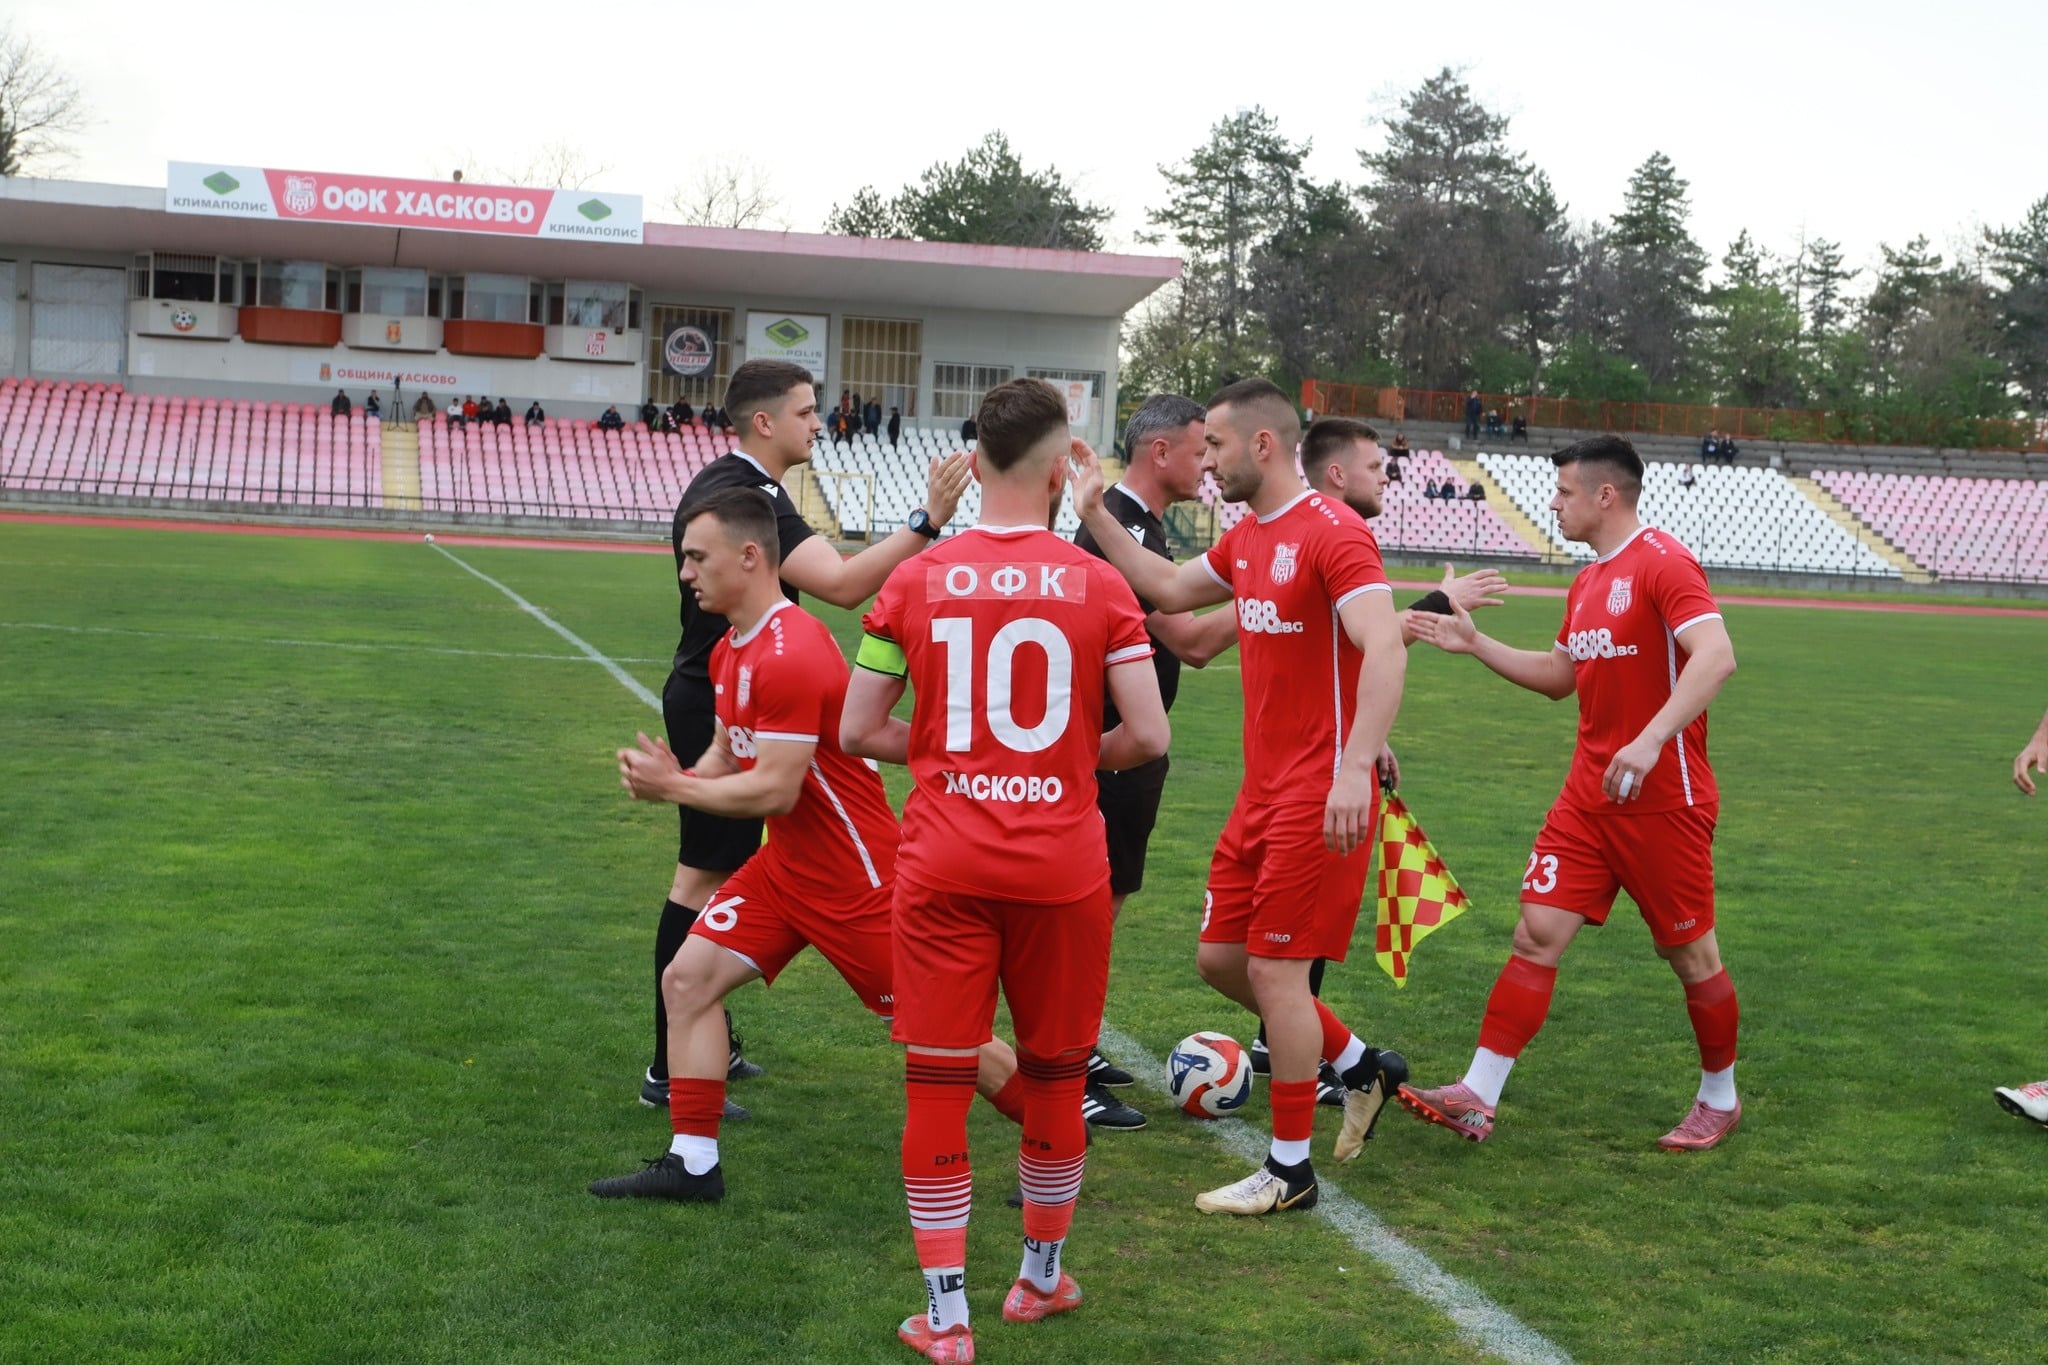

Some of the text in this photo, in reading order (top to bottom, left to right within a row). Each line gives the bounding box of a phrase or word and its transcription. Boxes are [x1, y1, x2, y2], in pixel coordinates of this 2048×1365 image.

[173, 196, 268, 212] КЛИМАПОЛИС
[322, 185, 535, 224] ОФК ХАСКОВО
[549, 223, 639, 239] КЛИМАПОЛИС
[337, 367, 393, 381] ОБЩИНА
[945, 565, 1066, 598] ОФК
[931, 616, 1073, 753] 10
[943, 770, 1063, 804] ХАСКОВО
[1522, 851, 1559, 894] 23
